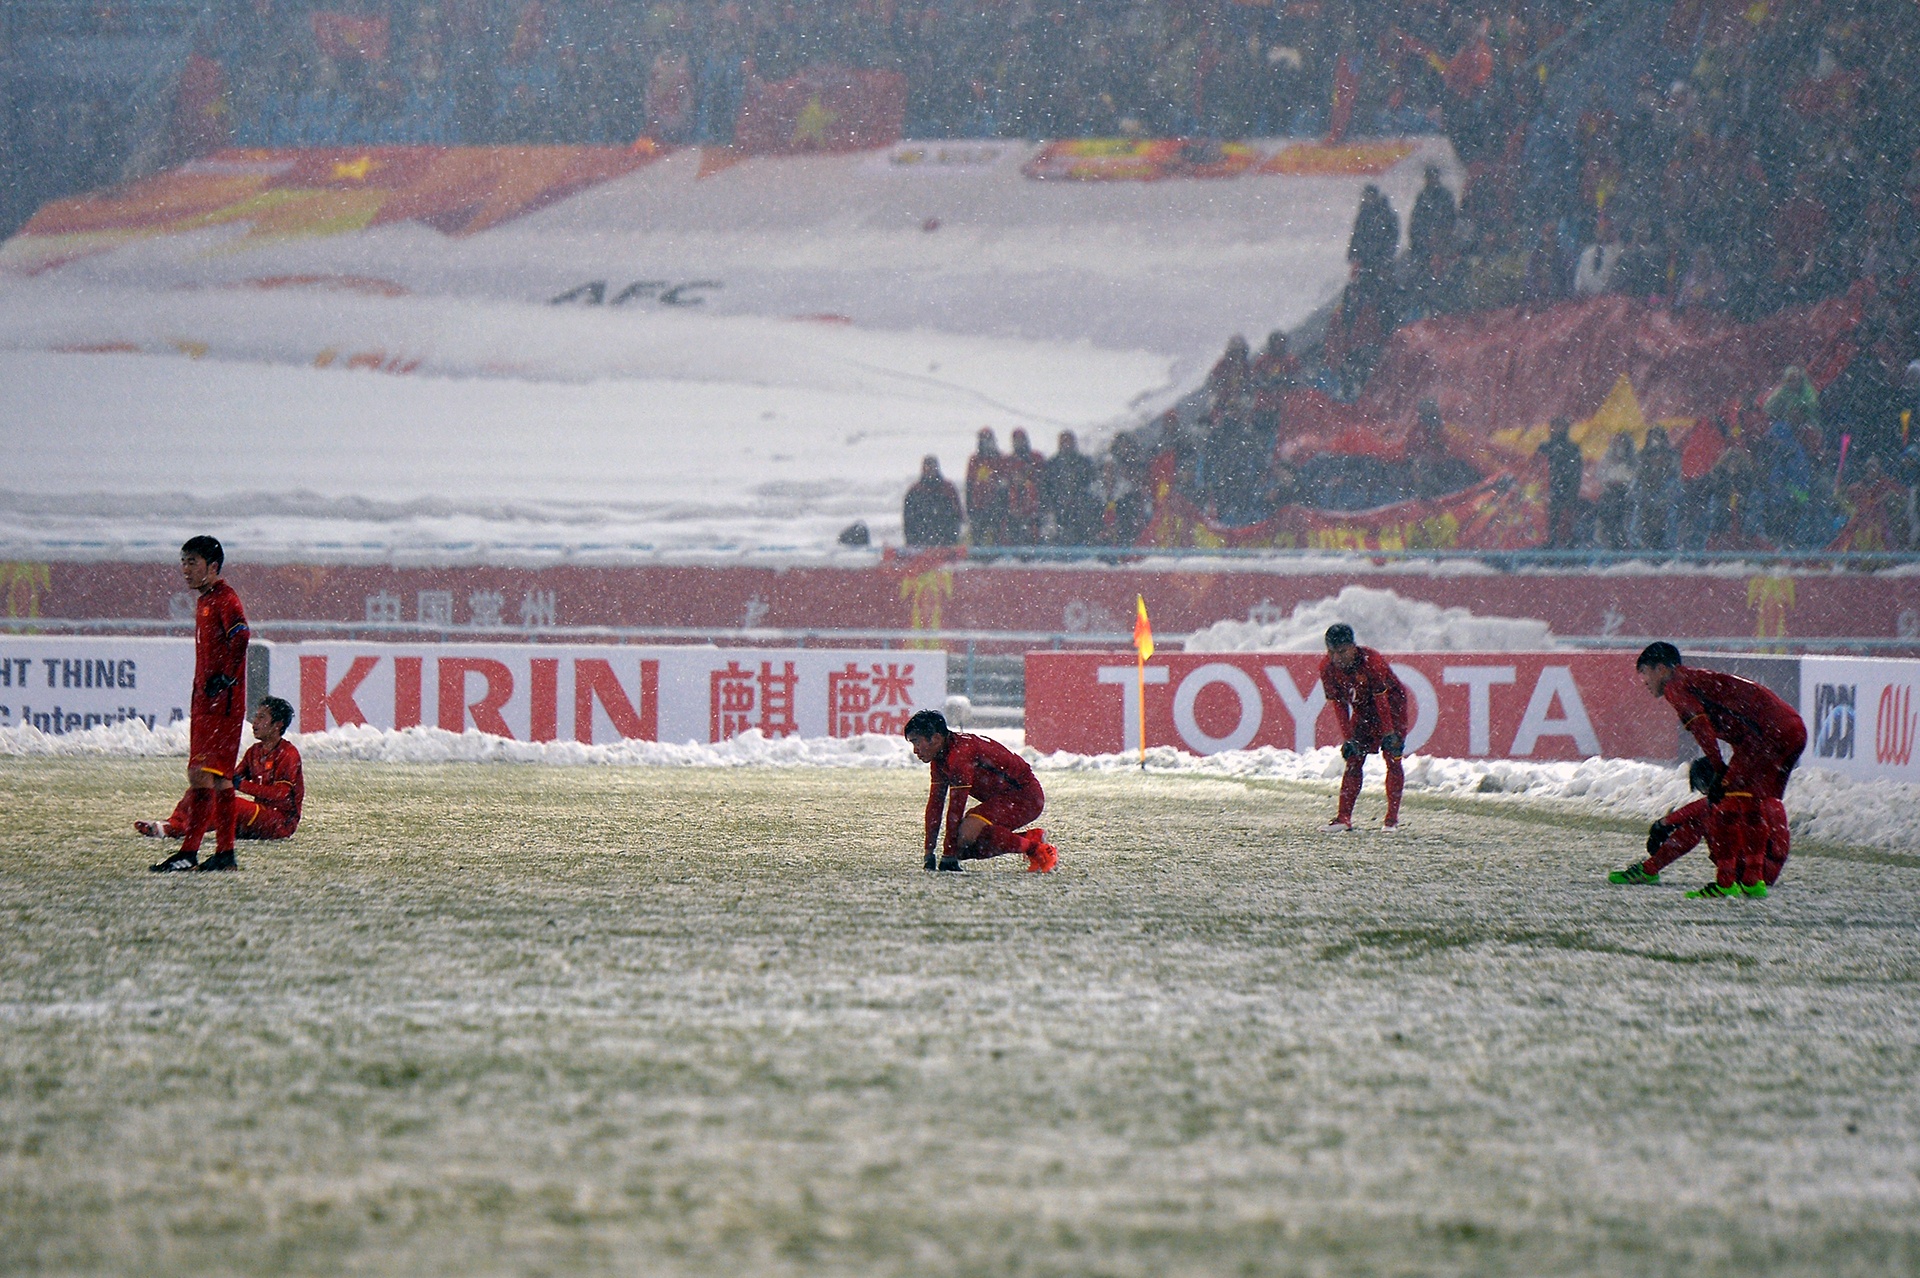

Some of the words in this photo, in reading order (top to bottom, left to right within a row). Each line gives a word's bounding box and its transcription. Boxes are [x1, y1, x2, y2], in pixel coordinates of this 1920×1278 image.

[548, 280, 723, 306] AFC
[42, 658, 137, 689] THING
[299, 656, 659, 744] KIRIN
[710, 661, 914, 743] 麒麟
